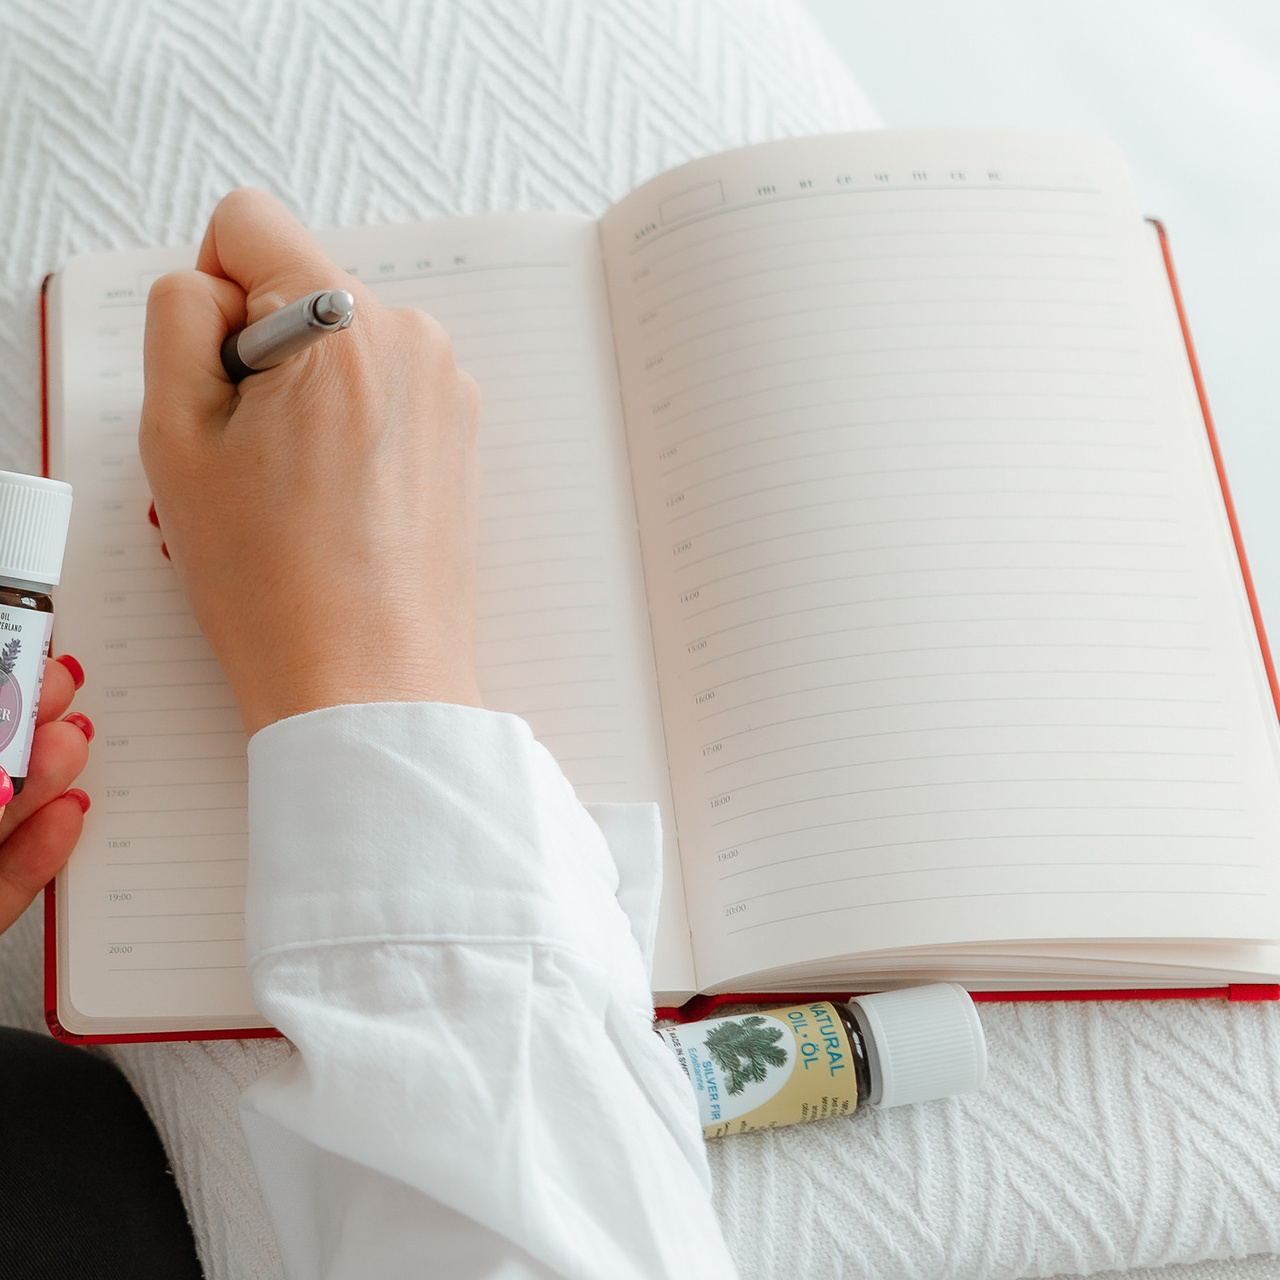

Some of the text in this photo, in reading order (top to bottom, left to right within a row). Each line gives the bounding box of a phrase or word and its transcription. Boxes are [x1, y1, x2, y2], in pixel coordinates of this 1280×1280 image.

[680, 590, 700, 604] 14:00
[0, 612, 10, 621] OIL
[687, 640, 707, 654] 15:00
[694, 691, 715, 705] 16:00
[702, 743, 723, 757] 17:00
[106, 789, 129, 798] 17:00
[710, 795, 731, 809] 18:00
[108, 840, 131, 849] 18:00
[717, 849, 739, 863] 19:00
[108, 893, 132, 902] 19:00
[724, 903, 747, 917] 20:00
[108, 945, 133, 954] 20:00
[668, 1031, 681, 1047] MADE
[675, 1048, 684, 1056] IN
[787, 1010, 820, 1071] OIL ÖL
[807, 1002, 845, 1078] NATURAL
[687, 1046, 705, 1091] Edeltanne
[702, 1059, 721, 1121] SILVER FIR
